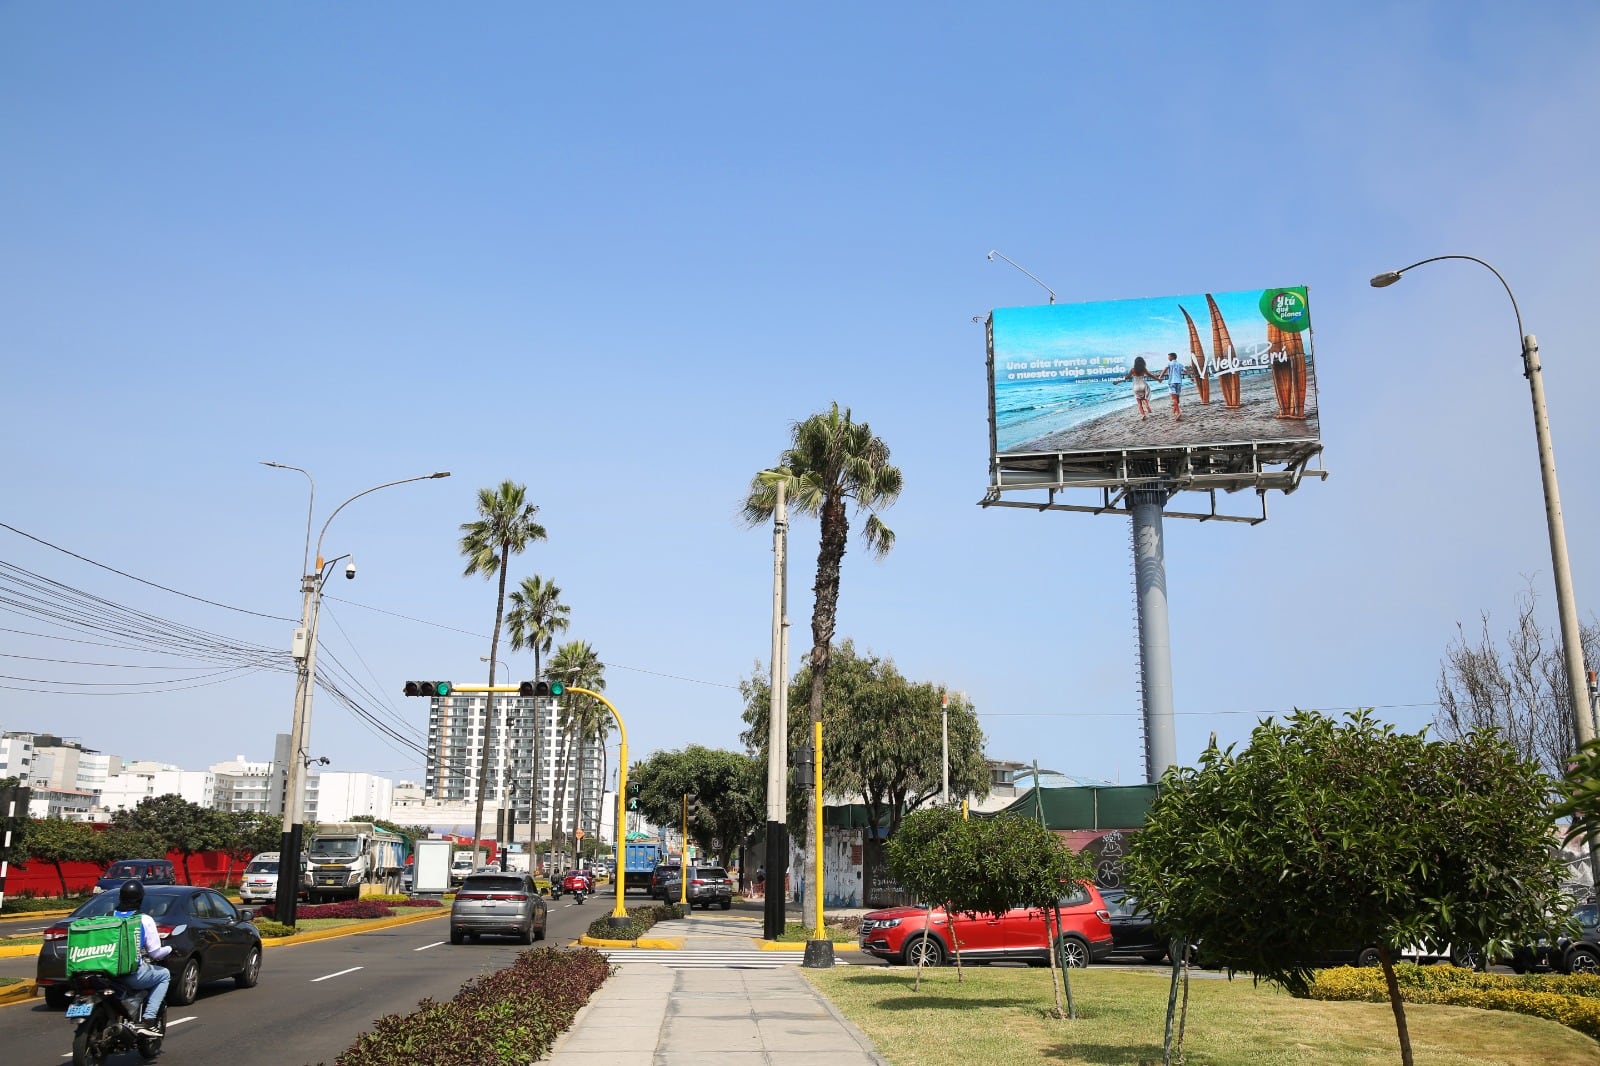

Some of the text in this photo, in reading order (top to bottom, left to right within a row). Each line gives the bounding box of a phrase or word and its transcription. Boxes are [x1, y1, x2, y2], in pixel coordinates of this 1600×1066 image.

[1246, 341, 1288, 366] Perú
[1006, 361, 1027, 370] Una
[1030, 359, 1051, 369] cita
[1054, 358, 1087, 367] frente
[1090, 356, 1100, 365] al
[1016, 369, 1058, 379] nuestro
[1059, 367, 1086, 378] viaje
[1087, 365, 1126, 375] soñado
[69, 942, 117, 963] Yummy
